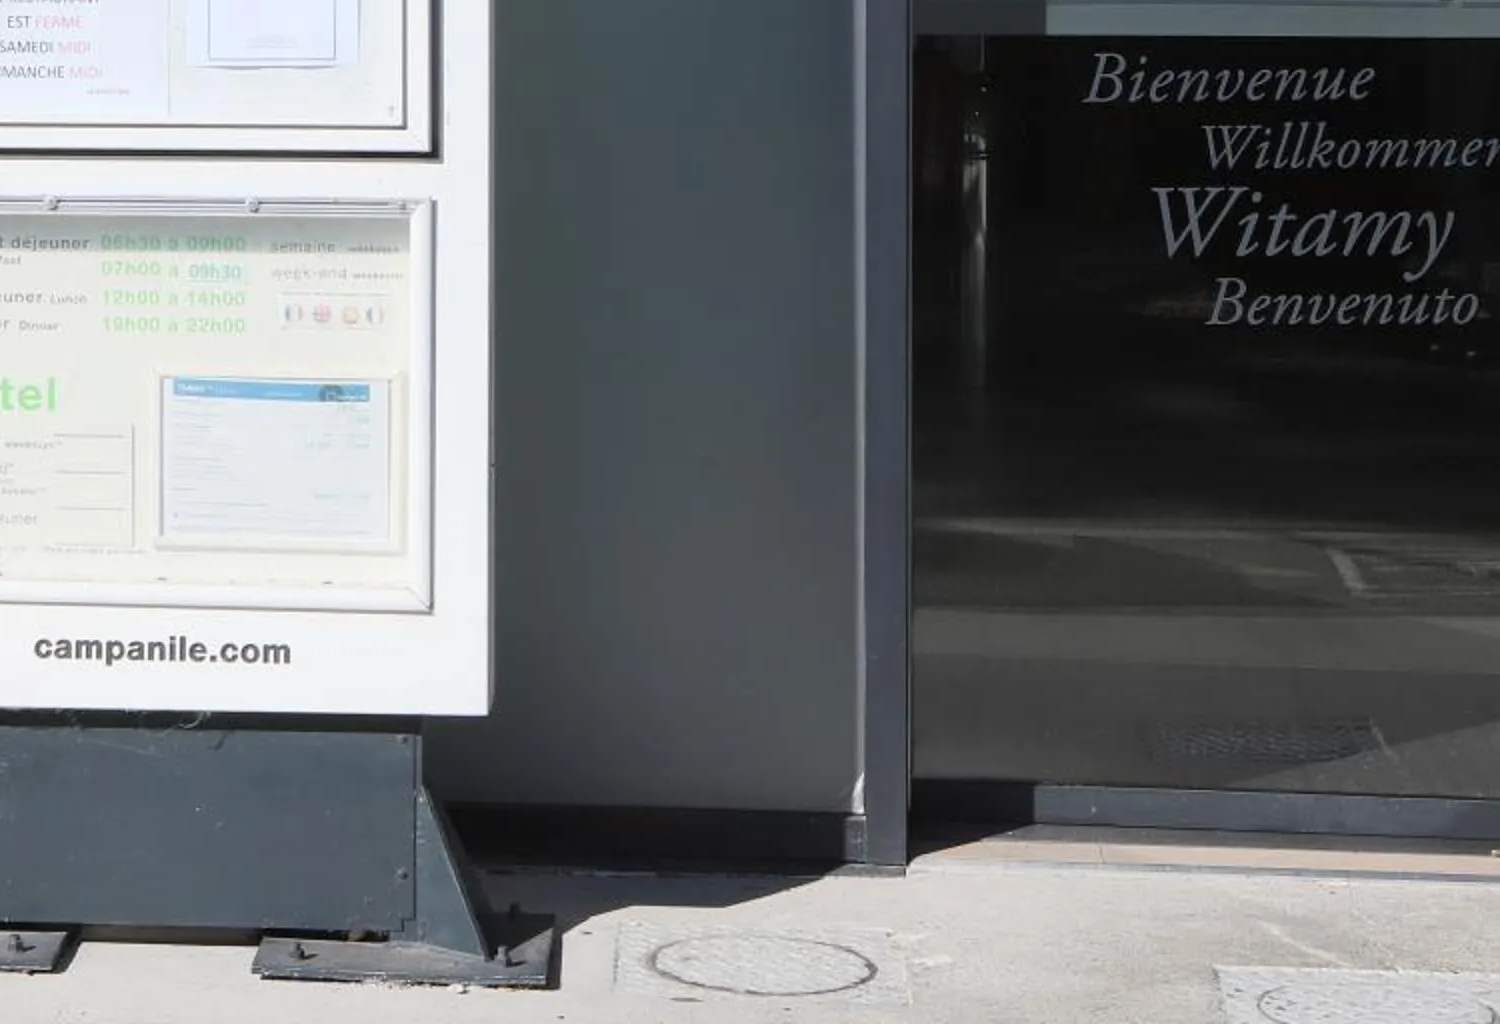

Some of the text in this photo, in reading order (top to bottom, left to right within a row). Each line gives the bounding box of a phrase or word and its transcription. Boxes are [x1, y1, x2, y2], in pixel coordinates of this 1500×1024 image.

[6, 15, 32, 29] EST
[57, 40, 91, 55] MIDI
[1081, 52, 1376, 104] Bienvenue
[1151, 186, 1455, 282] Witamy
[1203, 276, 1480, 326] Benvenuto
[33, 636, 292, 667] campanile.com
